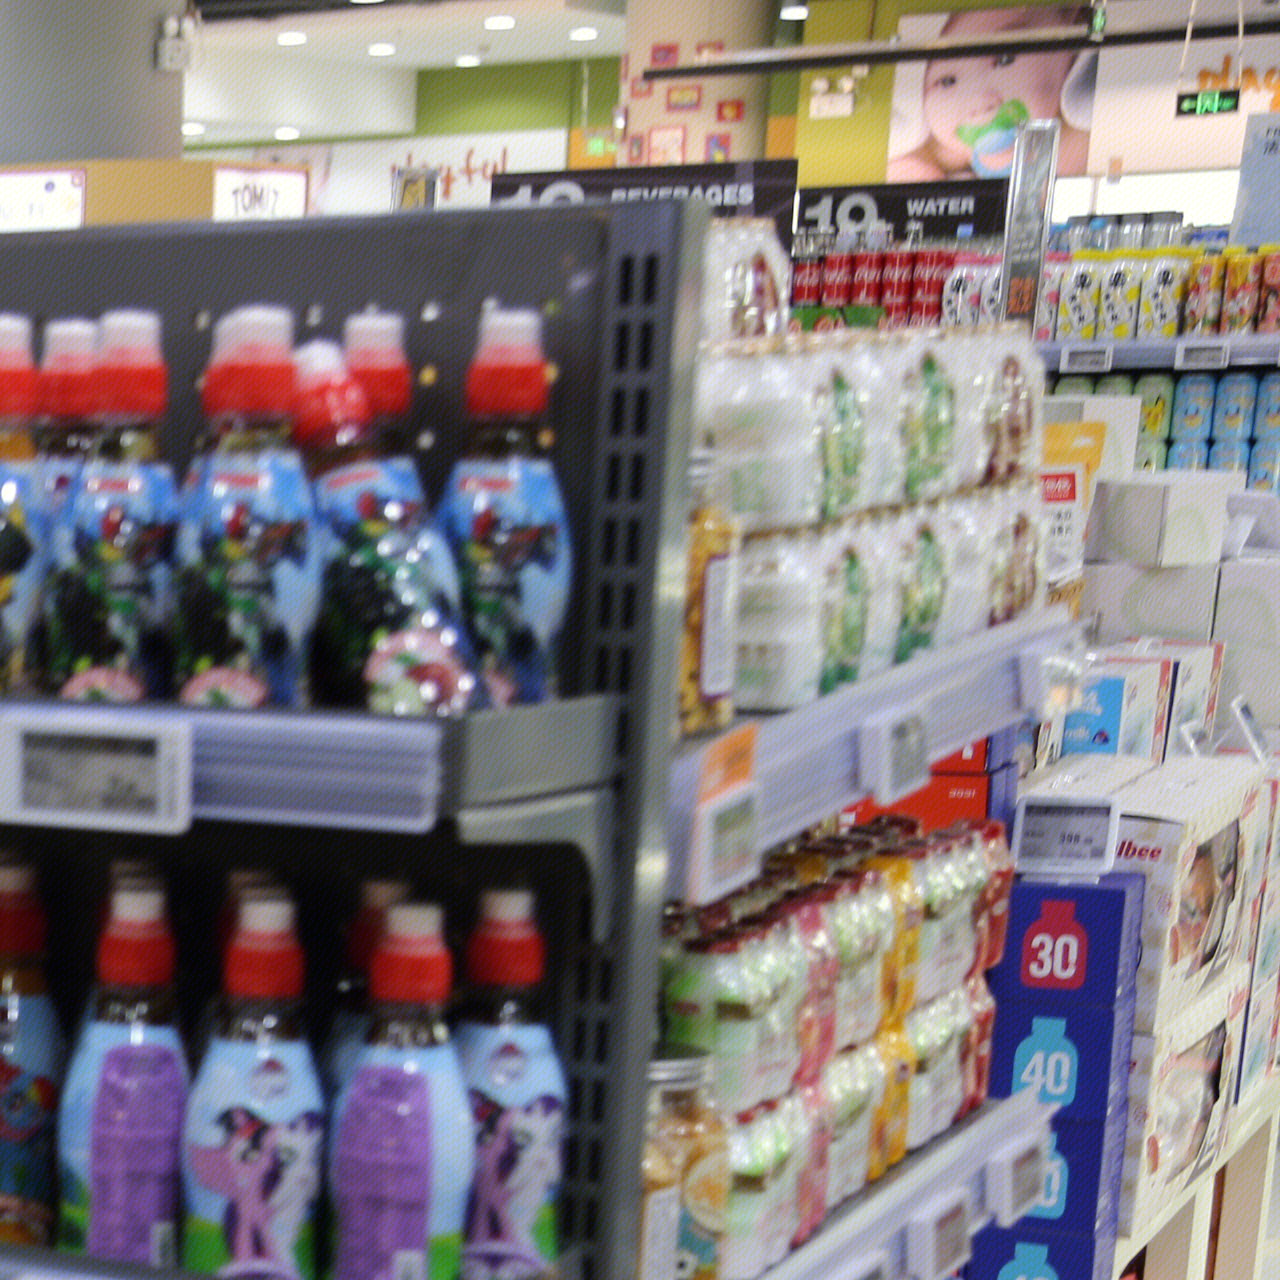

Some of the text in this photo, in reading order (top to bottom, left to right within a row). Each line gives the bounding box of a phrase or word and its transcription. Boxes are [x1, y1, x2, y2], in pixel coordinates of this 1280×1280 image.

[906, 197, 975, 217] WATER
[1028, 932, 1079, 981] 30
[1020, 1049, 1071, 1097] 40
